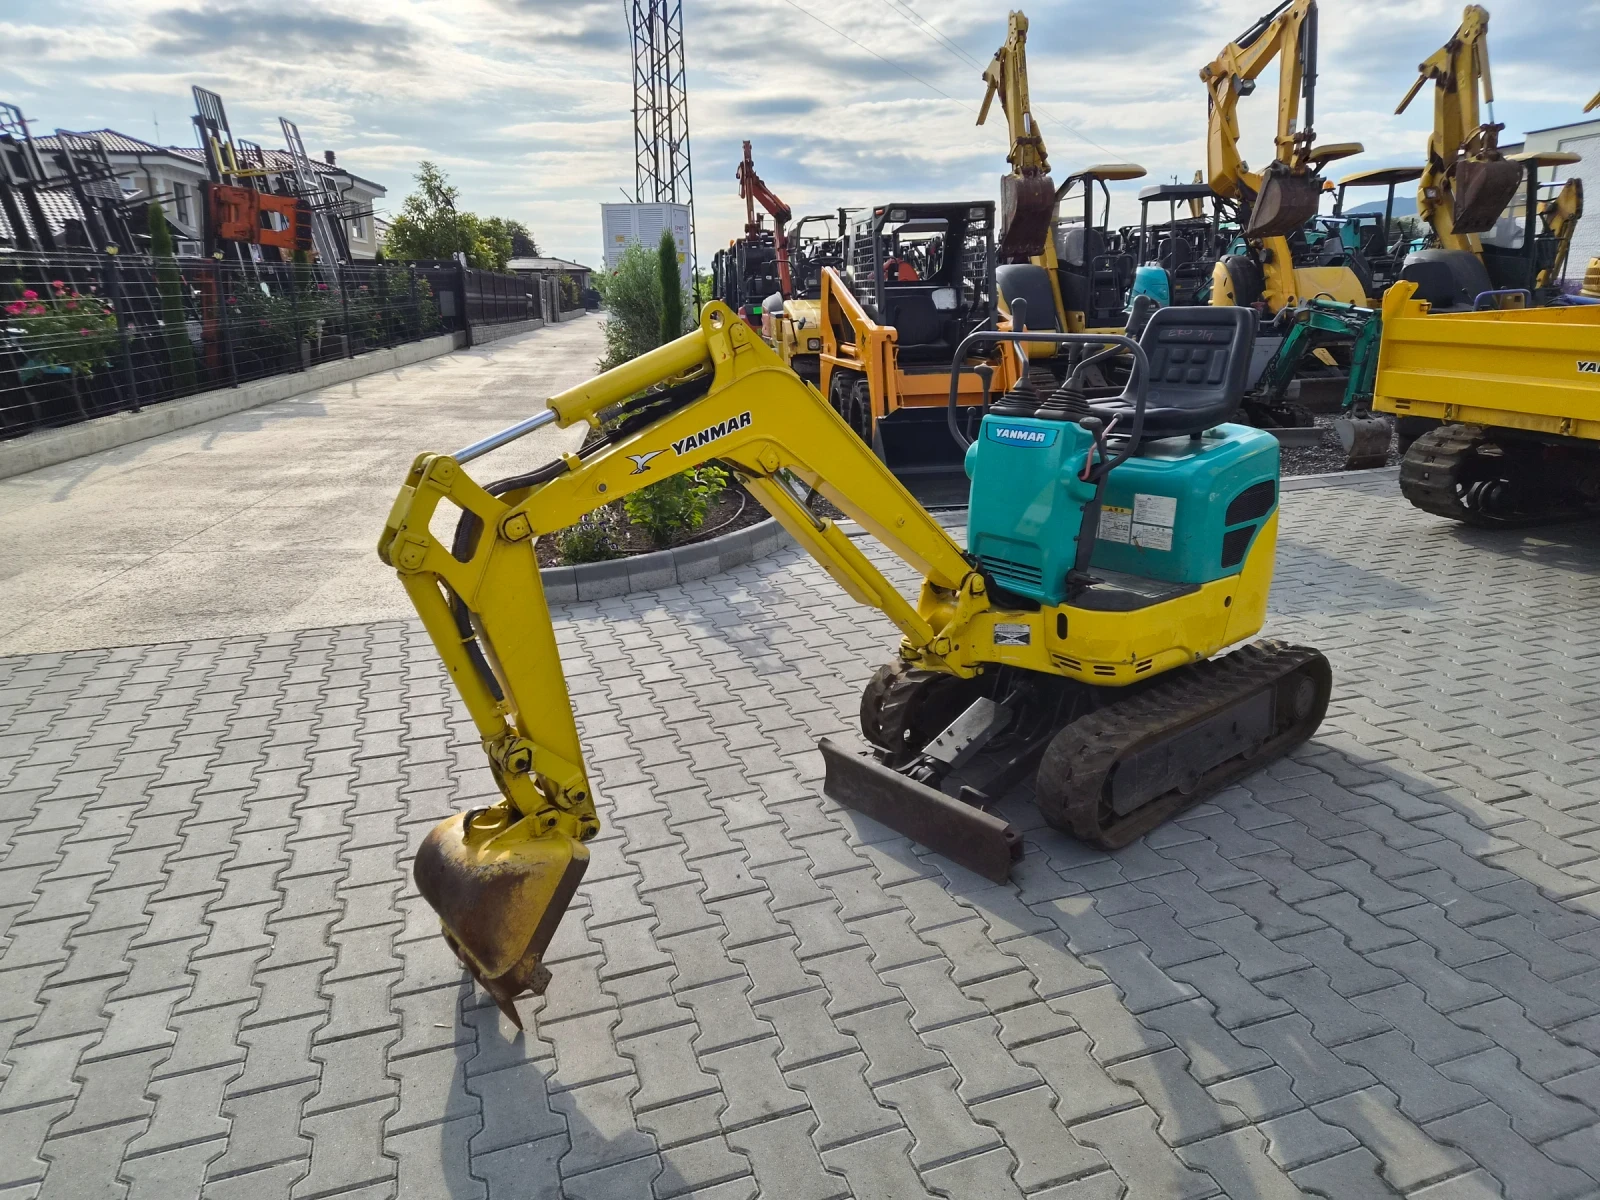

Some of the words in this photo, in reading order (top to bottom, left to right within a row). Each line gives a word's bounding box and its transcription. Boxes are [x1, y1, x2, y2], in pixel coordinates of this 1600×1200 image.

[1576, 361, 1600, 373] YA
[671, 411, 752, 457] YANMAR
[996, 428, 1046, 442] YANMAR
